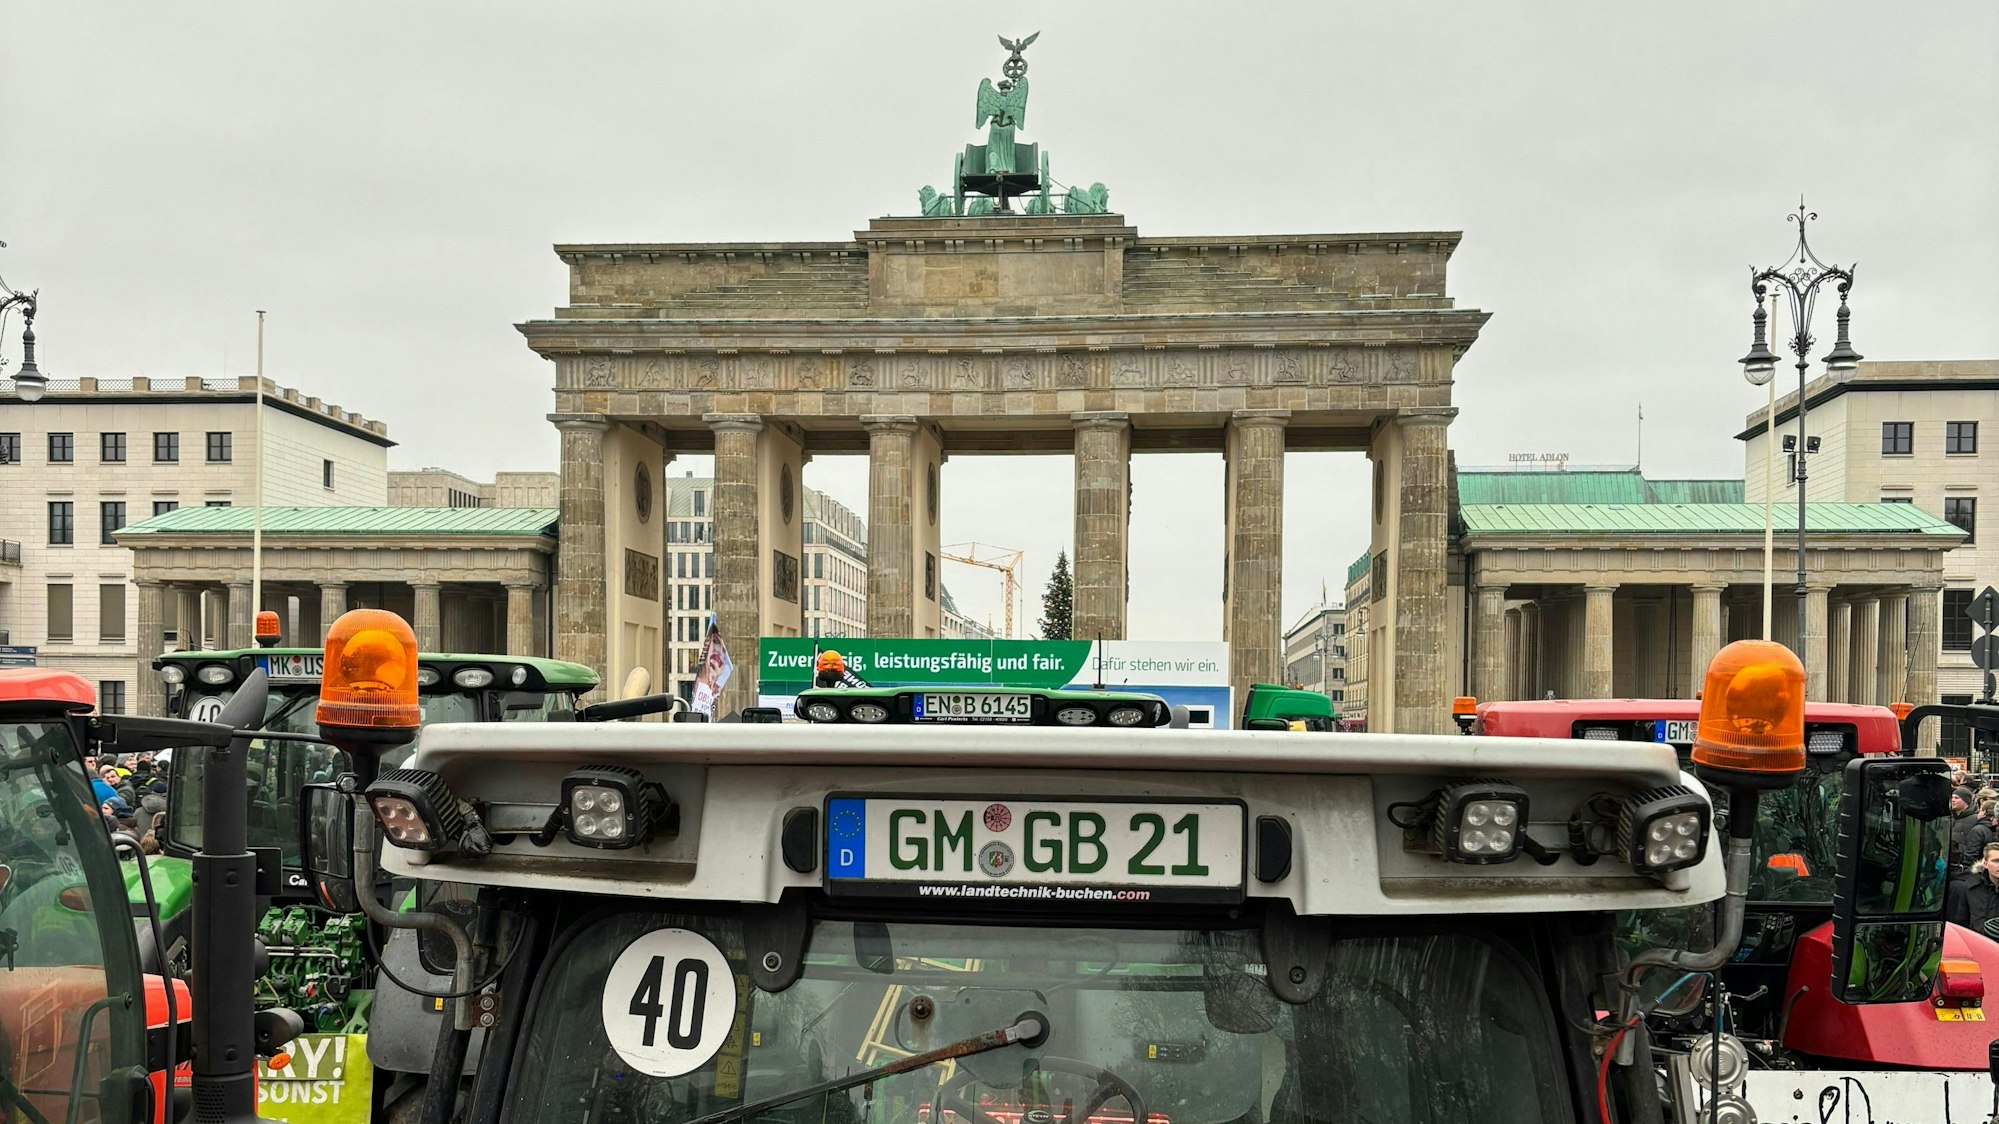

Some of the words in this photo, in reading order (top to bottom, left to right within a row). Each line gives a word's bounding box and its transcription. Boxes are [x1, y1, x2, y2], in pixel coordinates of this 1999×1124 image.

[1509, 453, 1537, 461] HOTEL
[1540, 453, 1569, 461] ADLON
[270, 656, 291, 675] MK
[768, 651, 867, 671] Zuversig,
[875, 651, 992, 673] leistungsfähig
[997, 653, 1027, 670] und
[1032, 653, 1065, 670] fair.
[1092, 656, 1127, 671] Dafür
[1130, 657, 1172, 672] stehen
[1175, 658, 1195, 672] wir
[1198, 659, 1219, 672] ein.
[925, 695, 951, 714] EN
[964, 696, 976, 714] B
[981, 696, 1029, 715] 6145
[1667, 722, 1689, 740] GM
[889, 809, 974, 872] GM
[1024, 811, 1108, 874] GB
[1128, 812, 1209, 876] 21
[840, 848, 854, 866] D
[919, 884, 1150, 900] www.landtechnik-buchen.com
[628, 955, 710, 1050] 40
[259, 1036, 347, 1079] RY!
